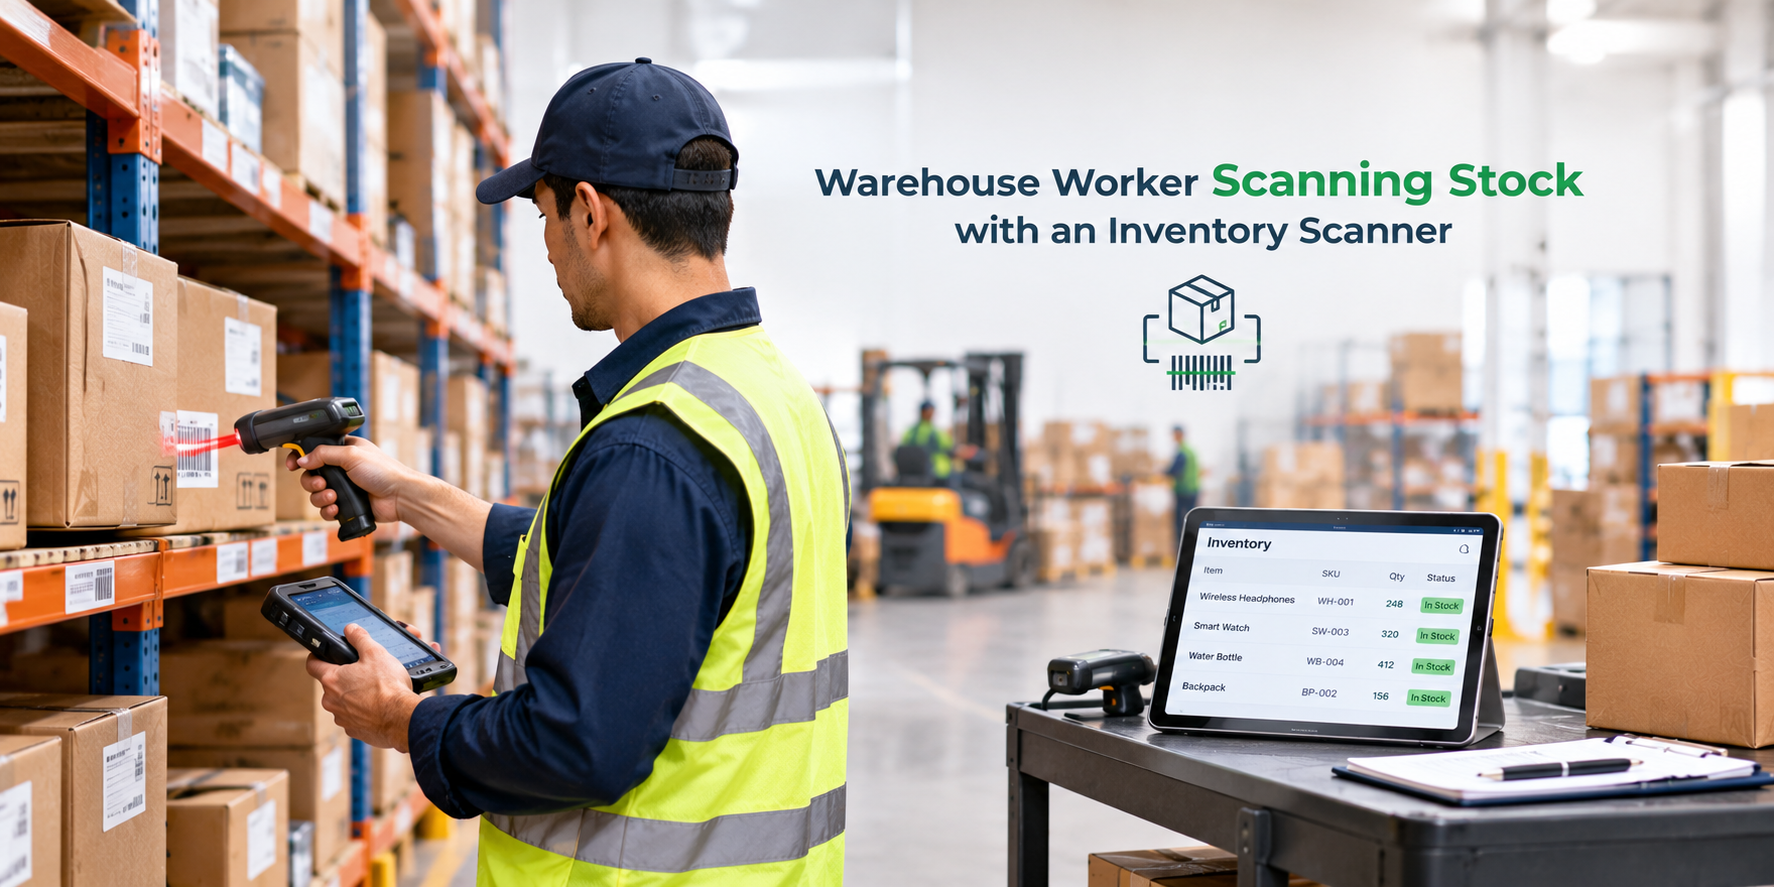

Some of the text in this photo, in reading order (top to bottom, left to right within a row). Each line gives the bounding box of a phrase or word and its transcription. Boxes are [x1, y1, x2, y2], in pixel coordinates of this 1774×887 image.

[1207, 536, 1272, 553] Inventory
[1203, 566, 1224, 575] Item
[1321, 569, 1341, 579] SKU
[1389, 571, 1406, 583] Qty
[1426, 573, 1456, 583] Status
[1199, 592, 1296, 605] Wireless Headphones
[1317, 596, 1354, 607] WH-001
[1385, 599, 1404, 609] 248
[1424, 600, 1460, 610] In Stock
[1193, 621, 1250, 632] Smart Watch
[1311, 626, 1350, 637] SW-003
[1381, 629, 1400, 639] 320
[1419, 631, 1456, 641] In Stock
[1188, 651, 1243, 662] Water Bottle
[1306, 656, 1344, 667] WB-004
[1377, 660, 1395, 670] 412
[1415, 662, 1451, 672] In Stock
[1181, 681, 1226, 693] Backpack
[1301, 687, 1338, 699] BP-002
[1372, 691, 1389, 701] 156
[1410, 693, 1446, 703] In Stock
